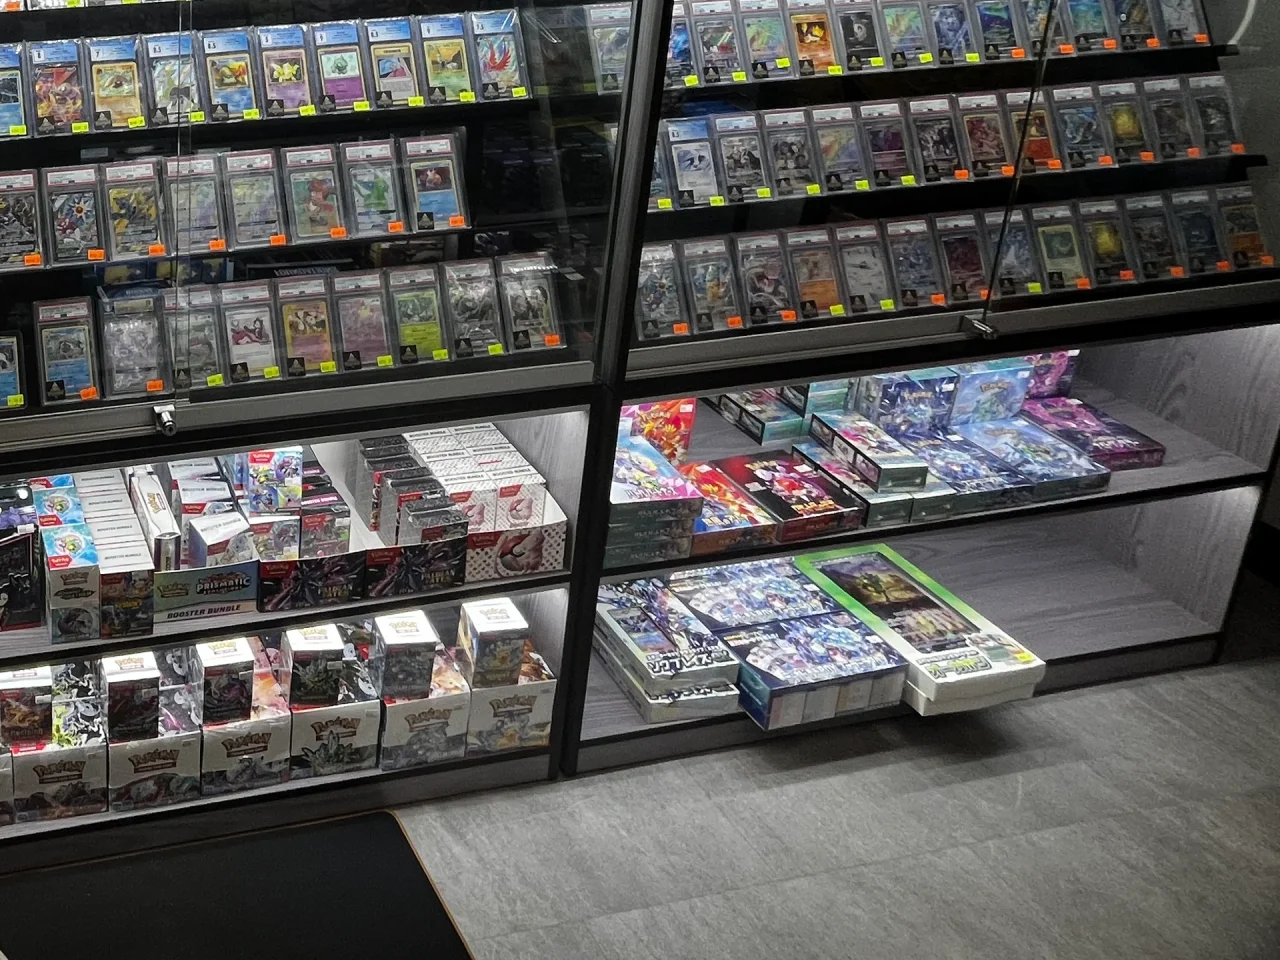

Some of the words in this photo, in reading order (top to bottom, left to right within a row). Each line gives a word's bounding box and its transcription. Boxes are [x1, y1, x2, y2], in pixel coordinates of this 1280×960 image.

[196, 573, 251, 593] PRISMATIC
[167, 608, 206, 619] BOOSTER
[208, 604, 241, 615] BUNDLE
